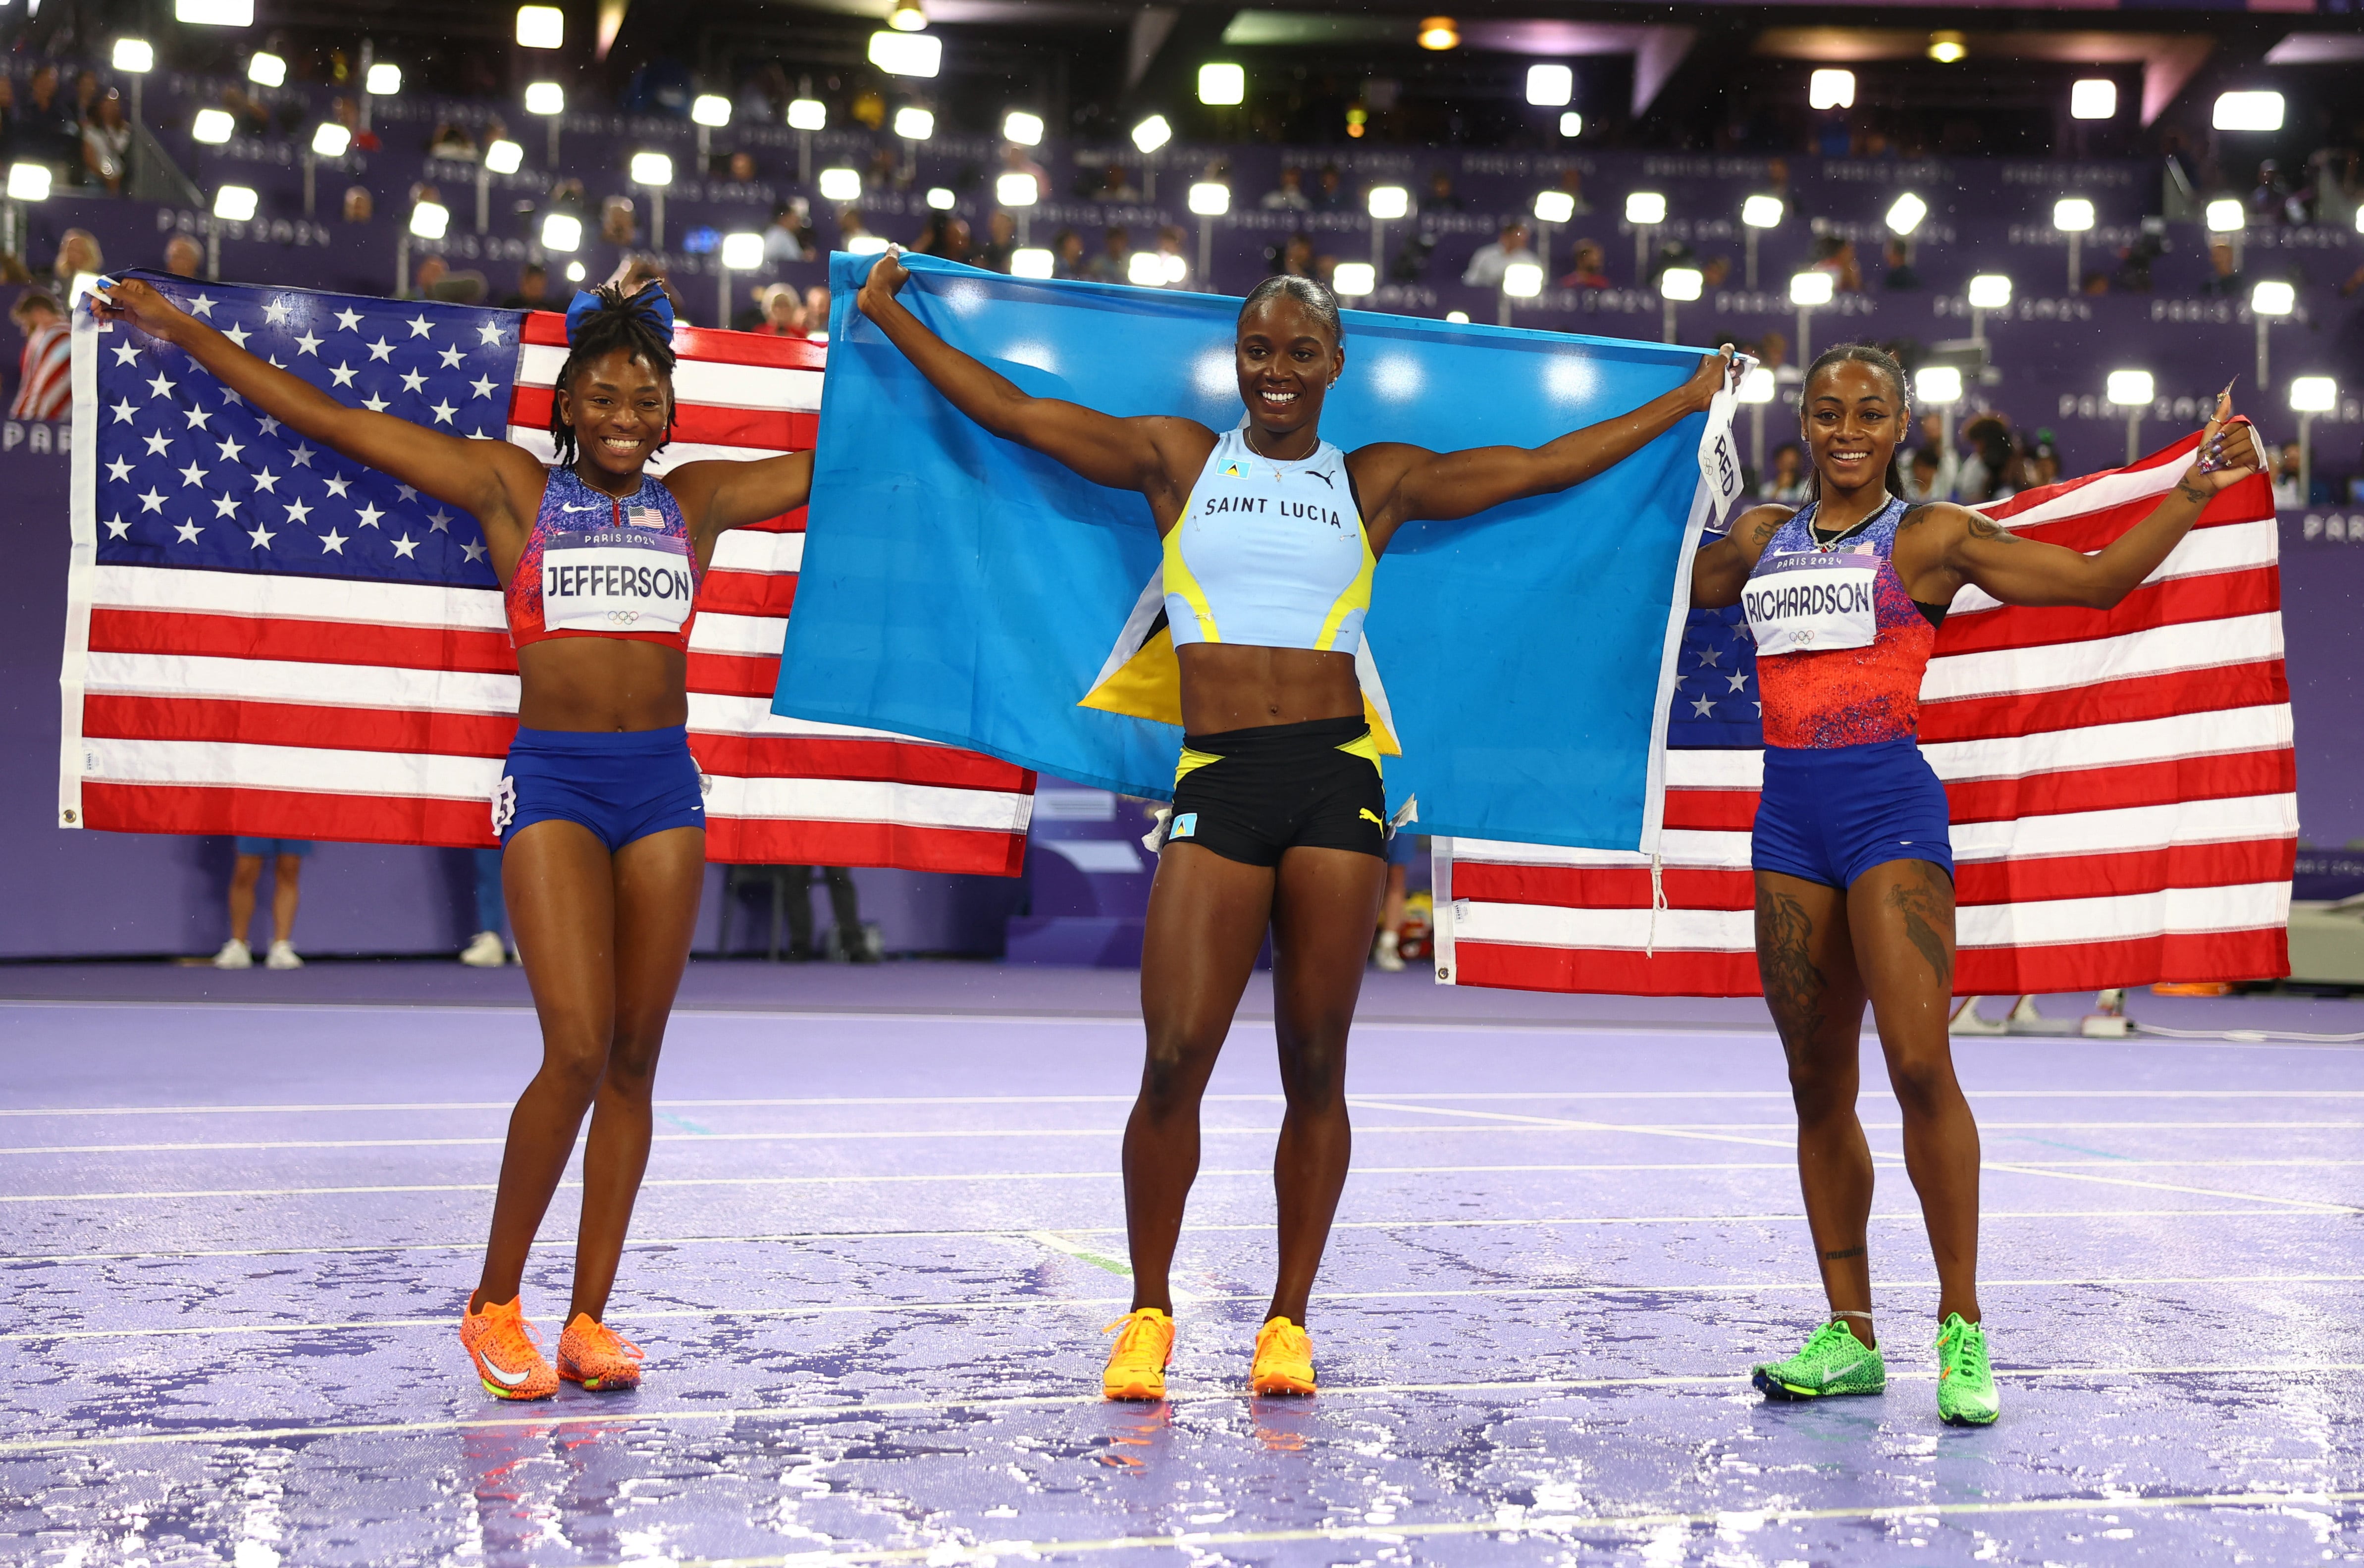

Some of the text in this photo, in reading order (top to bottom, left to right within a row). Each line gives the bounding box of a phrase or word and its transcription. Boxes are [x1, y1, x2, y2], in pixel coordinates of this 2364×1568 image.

[1205, 496, 1342, 529] SAINT LUCIA
[584, 533, 655, 546] PARIS 2024
[1776, 556, 1842, 569] PARIS 2024
[548, 565, 689, 601] JEFFERSON
[1745, 581, 1870, 624] RICHARDSON
